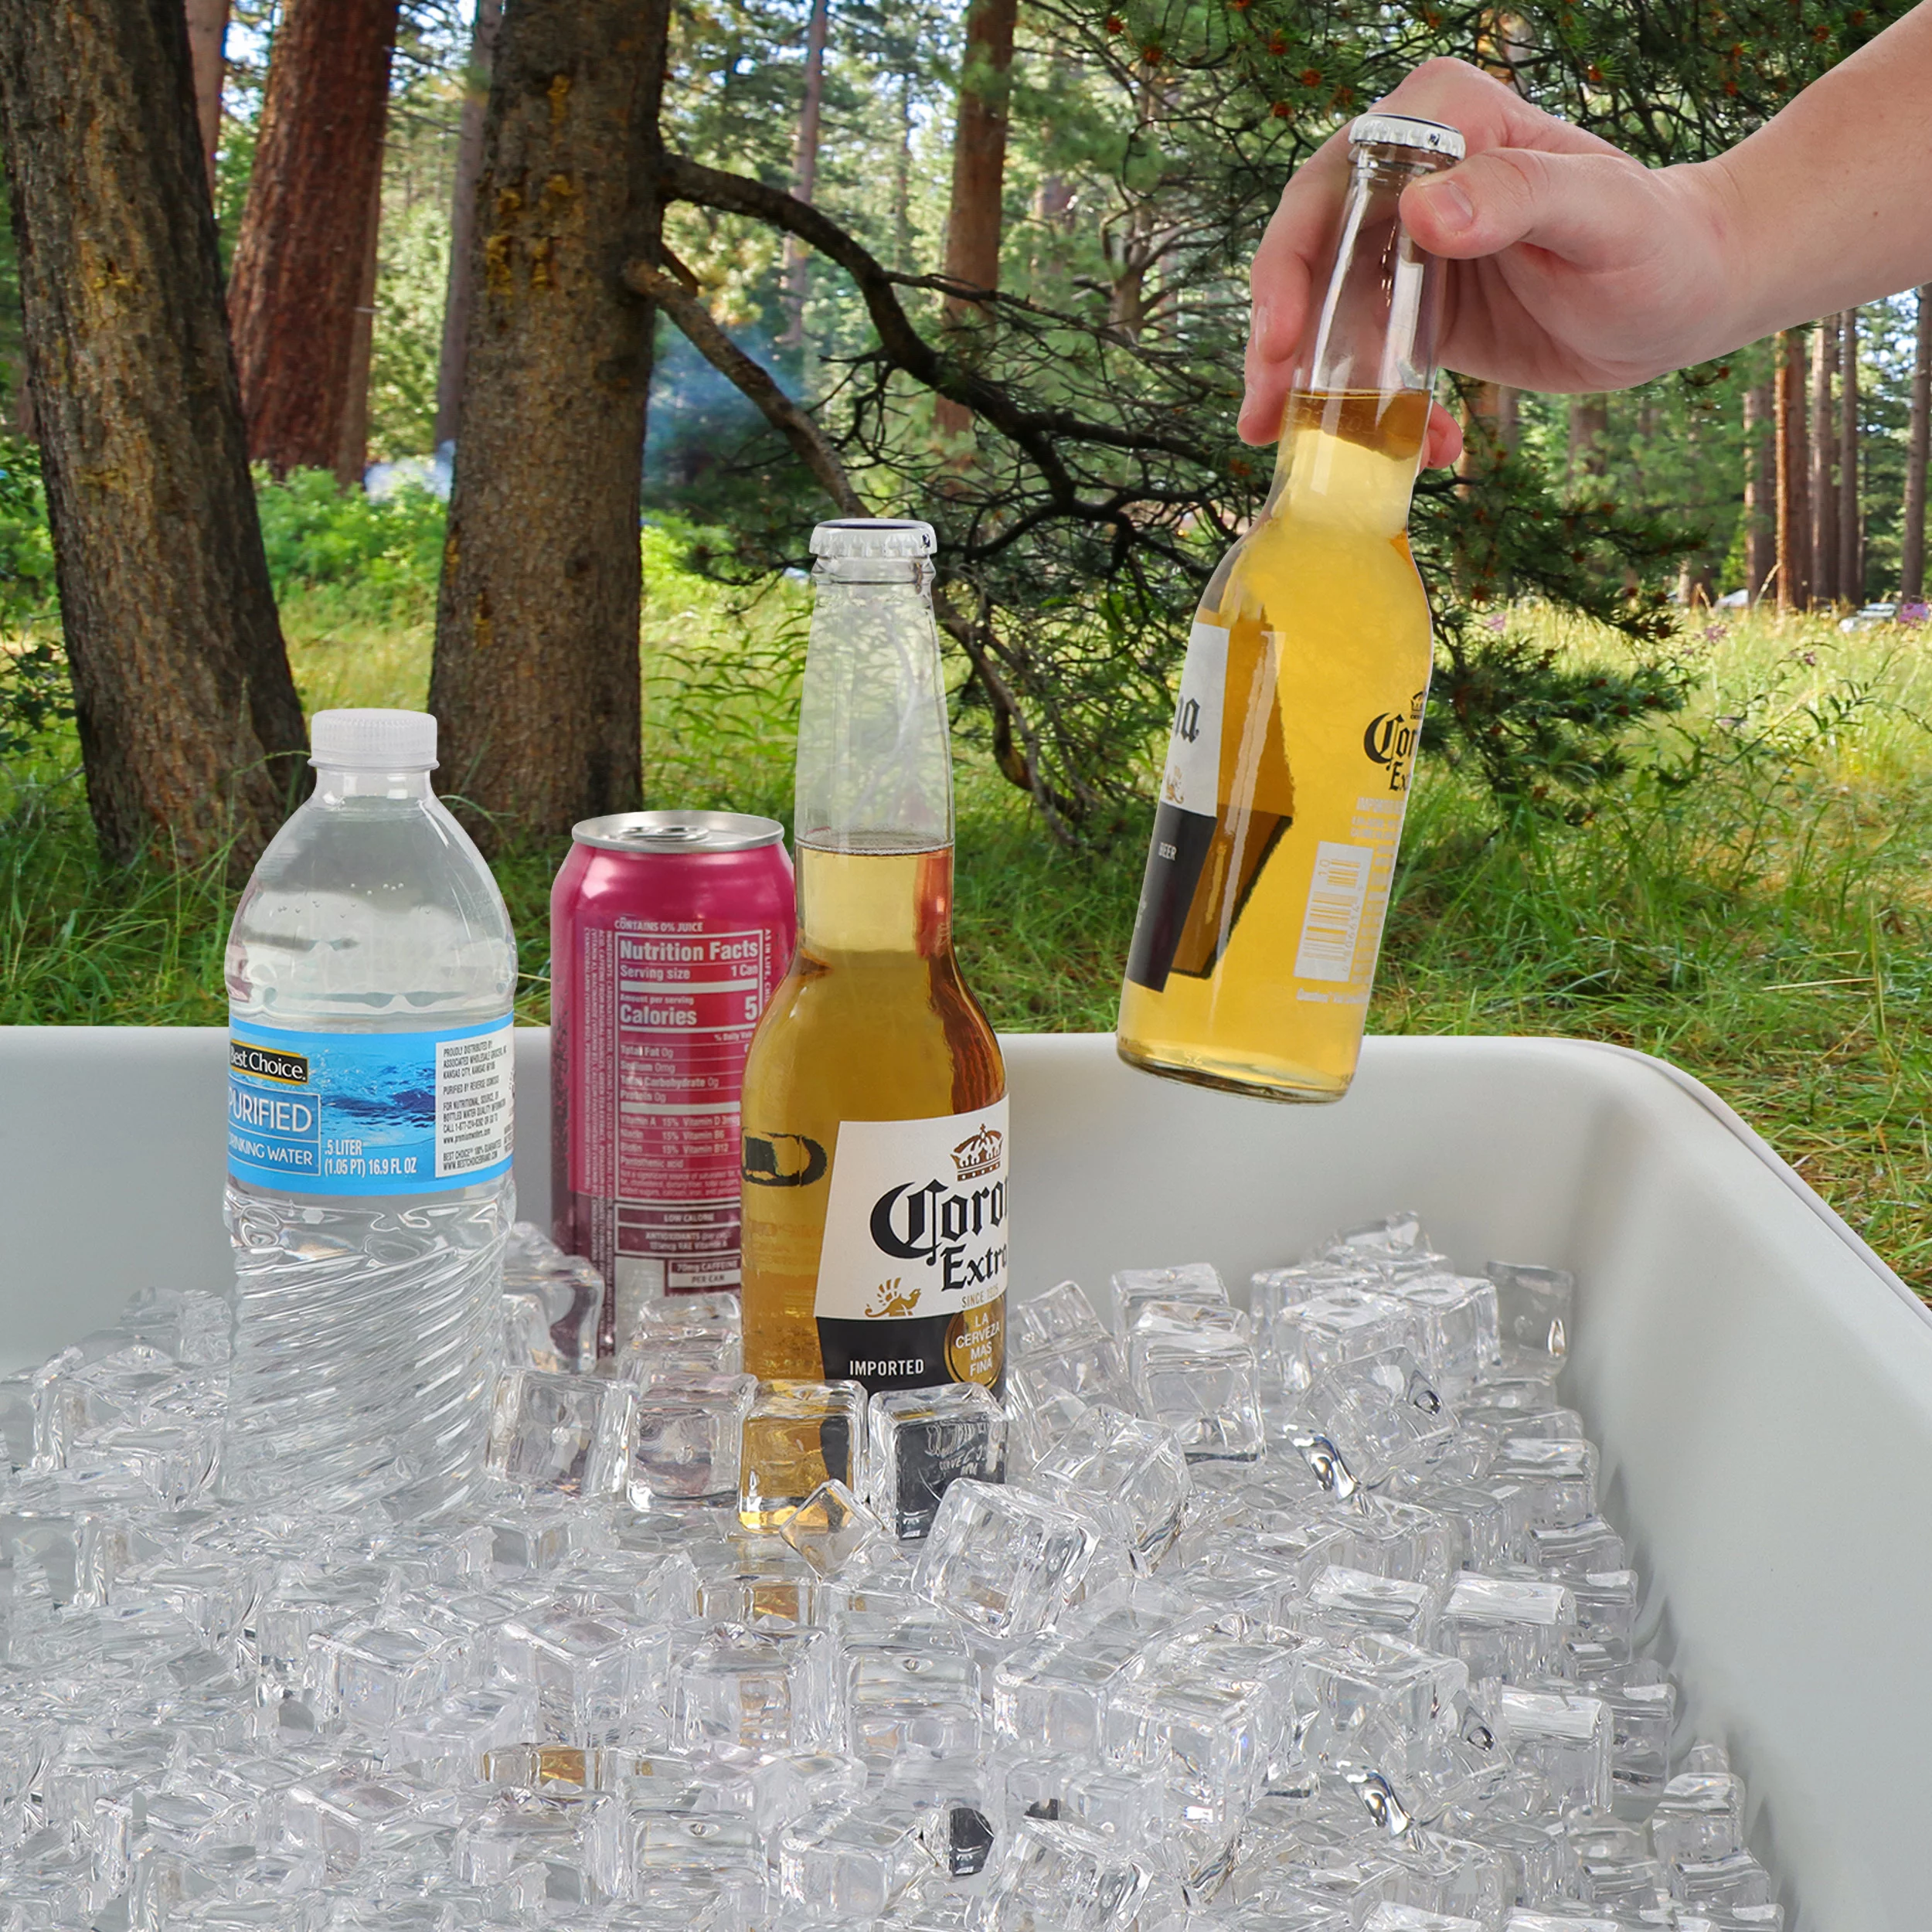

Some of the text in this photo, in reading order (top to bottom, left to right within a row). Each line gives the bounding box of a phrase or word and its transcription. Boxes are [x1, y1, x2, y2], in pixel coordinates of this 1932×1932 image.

[1158, 842, 1176, 861] BEER
[660, 922, 675, 931] 0%
[677, 922, 703, 932] JUICE
[620, 940, 758, 961] Nutrition Facts
[621, 965, 691, 981] Serving size
[731, 964, 758, 977] 1 Can
[620, 994, 694, 1005] Amount per serving
[621, 995, 757, 1026] Calories 5
[723, 1032, 740, 1042] Daily
[621, 1045, 674, 1059] Total Fat 0g
[621, 1060, 675, 1074] Sodium 0mg
[444, 1083, 463, 1095] PURIFIED
[621, 1075, 719, 1090] Total Carbohydrate 0g
[621, 1090, 666, 1103] Protein 0g
[444, 1101, 452, 1111] FOR
[621, 1114, 648, 1125] Vitamin
[650, 1117, 656, 1126] A
[682, 1117, 712, 1127] Vitamin
[714, 1116, 720, 1125] D
[682, 1130, 724, 1141] Vitamin B6
[325, 1139, 362, 1155] .5 LITER
[682, 1143, 729, 1154] Vitamin B12
[267, 1145, 313, 1165] WATER
[444, 1151, 454, 1162] BEST
[325, 1157, 417, 1179] (1.05 PT) 16.9 FL OZ
[683, 1213, 714, 1222] CALORIE
[645, 1231, 699, 1240] ANTIOXIDANTS
[701, 1260, 737, 1271] CAFFEINE
[709, 1274, 724, 1283] CAN
[961, 1290, 984, 1308] SINCE
[975, 1312, 989, 1327] LA
[955, 1321, 1001, 1349] CERVEZA
[970, 1342, 992, 1360] MAS
[849, 1358, 924, 1376] IMPORTED
[970, 1358, 992, 1377] FINA
